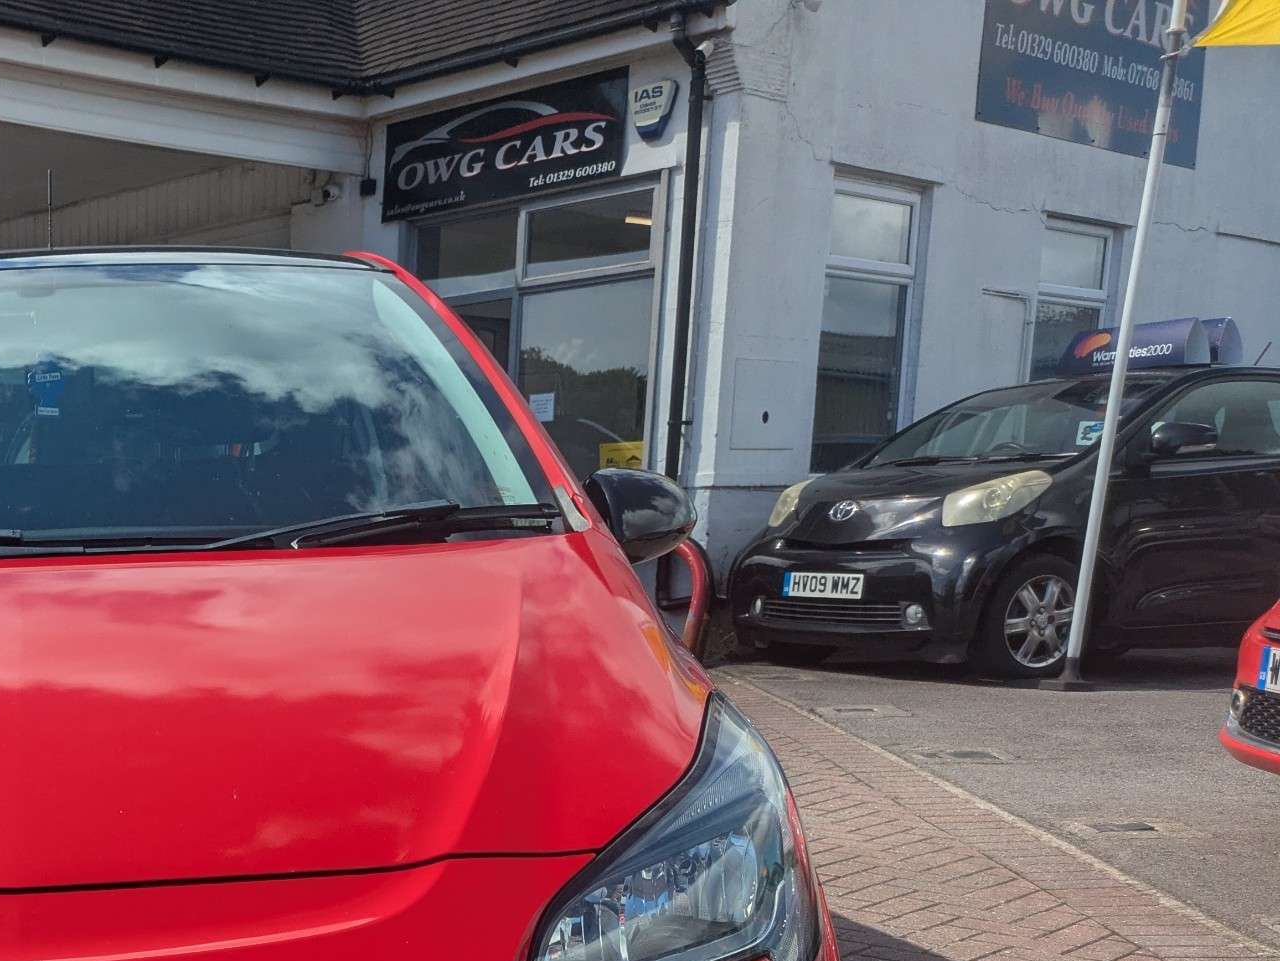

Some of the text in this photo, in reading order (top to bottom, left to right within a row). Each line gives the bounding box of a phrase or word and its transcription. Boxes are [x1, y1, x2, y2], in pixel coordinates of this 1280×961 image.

[995, 22, 1015, 50] Tel:
[1018, 30, 1052, 60] 01329
[1054, 41, 1098, 73] 600380
[1102, 55, 1126, 80] Mob:
[1128, 62, 1160, 90] 07768
[634, 85, 663, 103] IAS
[398, 121, 607, 190] OWG CARS
[529, 160, 616, 187] Tel: 01329 600380
[1092, 343, 1173, 362] Warrties2000
[792, 575, 861, 595] HV09 WMZ
